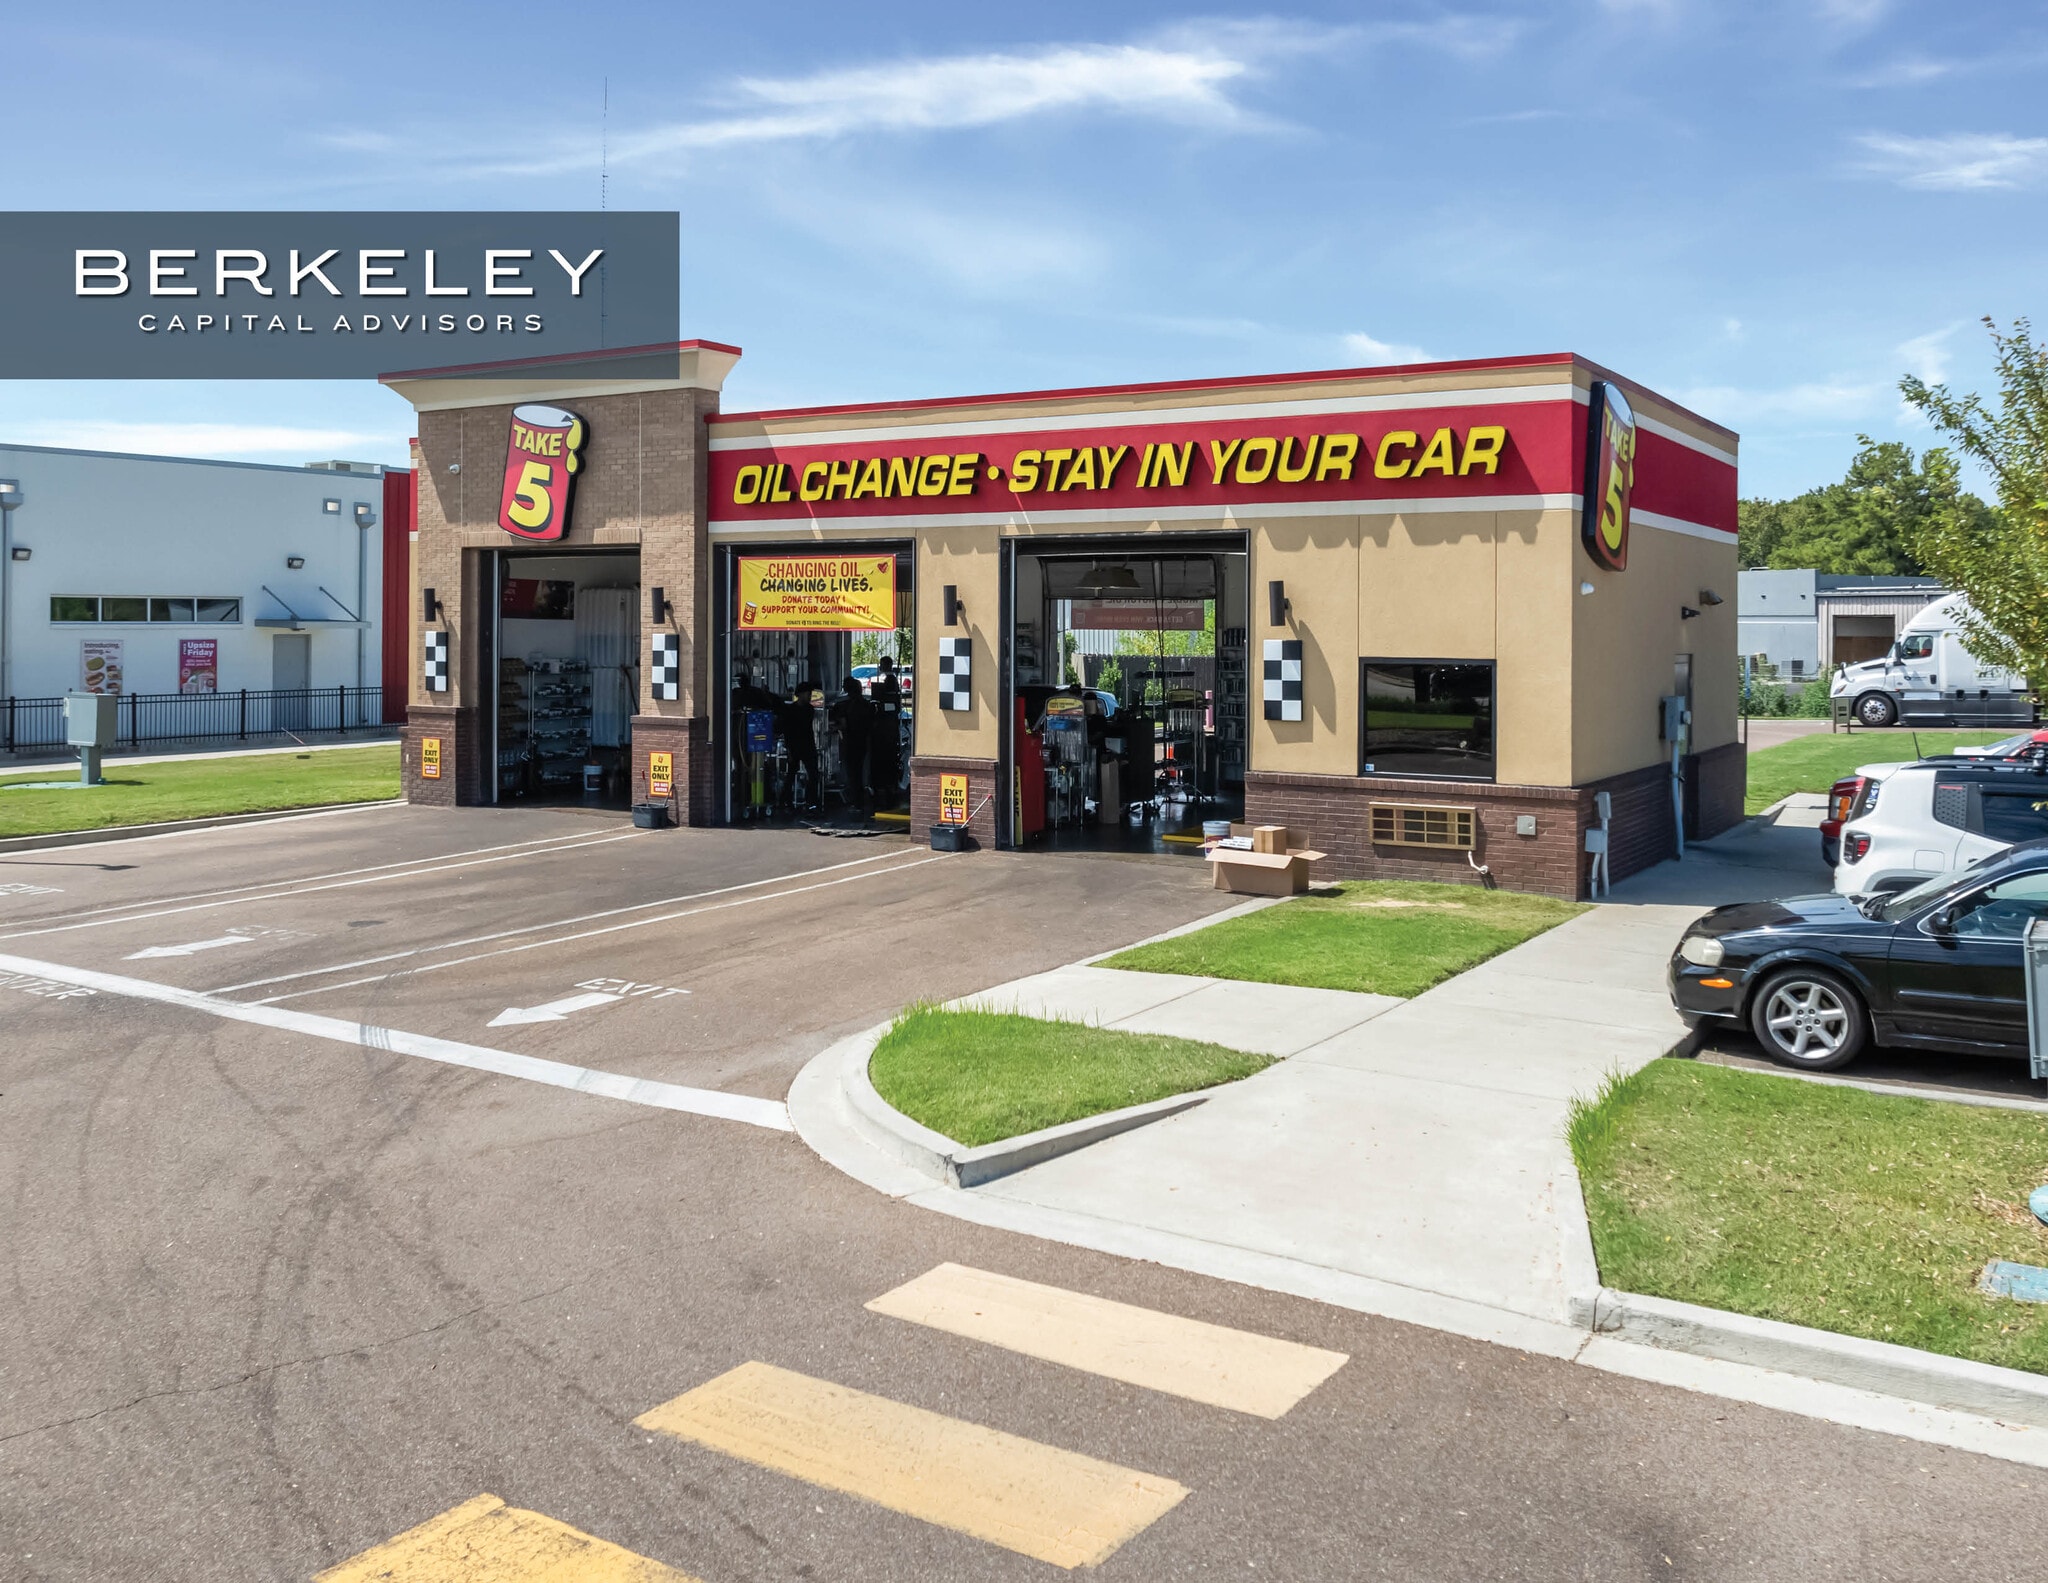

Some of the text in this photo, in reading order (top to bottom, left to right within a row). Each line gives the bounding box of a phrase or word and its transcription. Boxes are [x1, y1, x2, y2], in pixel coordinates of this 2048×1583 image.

[513, 424, 562, 457] TAKE
[1604, 408, 1630, 463] TAKE
[733, 425, 1507, 505] OIL CHANGE STAY IN YOUR CAR
[507, 459, 552, 528] 5
[1601, 460, 1624, 550] 5
[768, 561, 864, 578] CHANGING OIL.
[760, 577, 873, 592] CHANGING LIVES.
[782, 595, 813, 604] DONATE
[814, 595, 841, 603] TODAY
[761, 605, 797, 614] SUPPORT
[797, 605, 819, 614] YOUR
[187, 641, 215, 650] Upsize
[187, 648, 213, 658] Friday
[943, 797, 965, 805] ONLY
[944, 789, 963, 797] EXIT
[574, 978, 693, 999] EXIT
